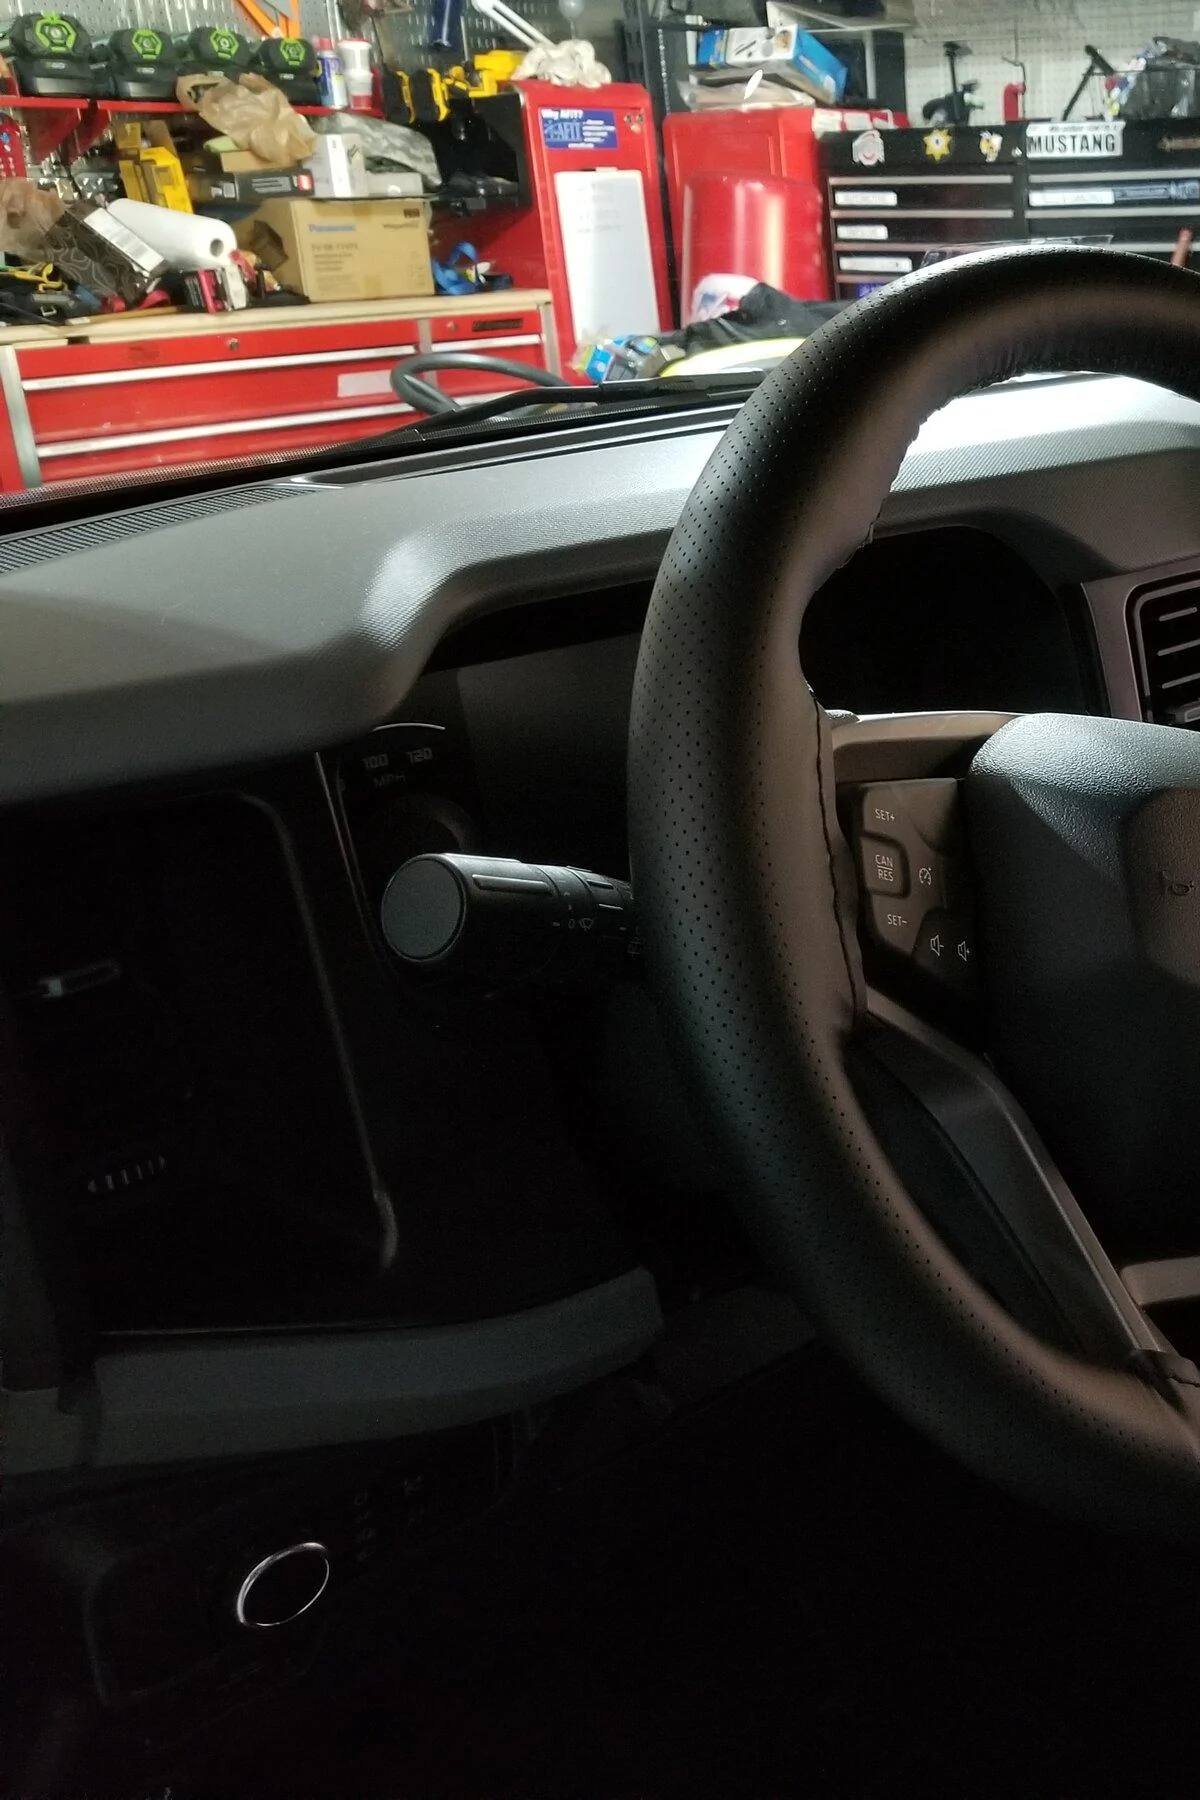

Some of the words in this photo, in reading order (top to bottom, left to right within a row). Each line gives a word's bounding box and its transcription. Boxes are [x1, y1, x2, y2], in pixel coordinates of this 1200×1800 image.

[1026, 133, 1115, 153] MUSTANG
[874, 808, 895, 822] SET+
[875, 854, 893, 867] CAN
[878, 869, 894, 882] RES
[887, 913, 907, 926] SET-
